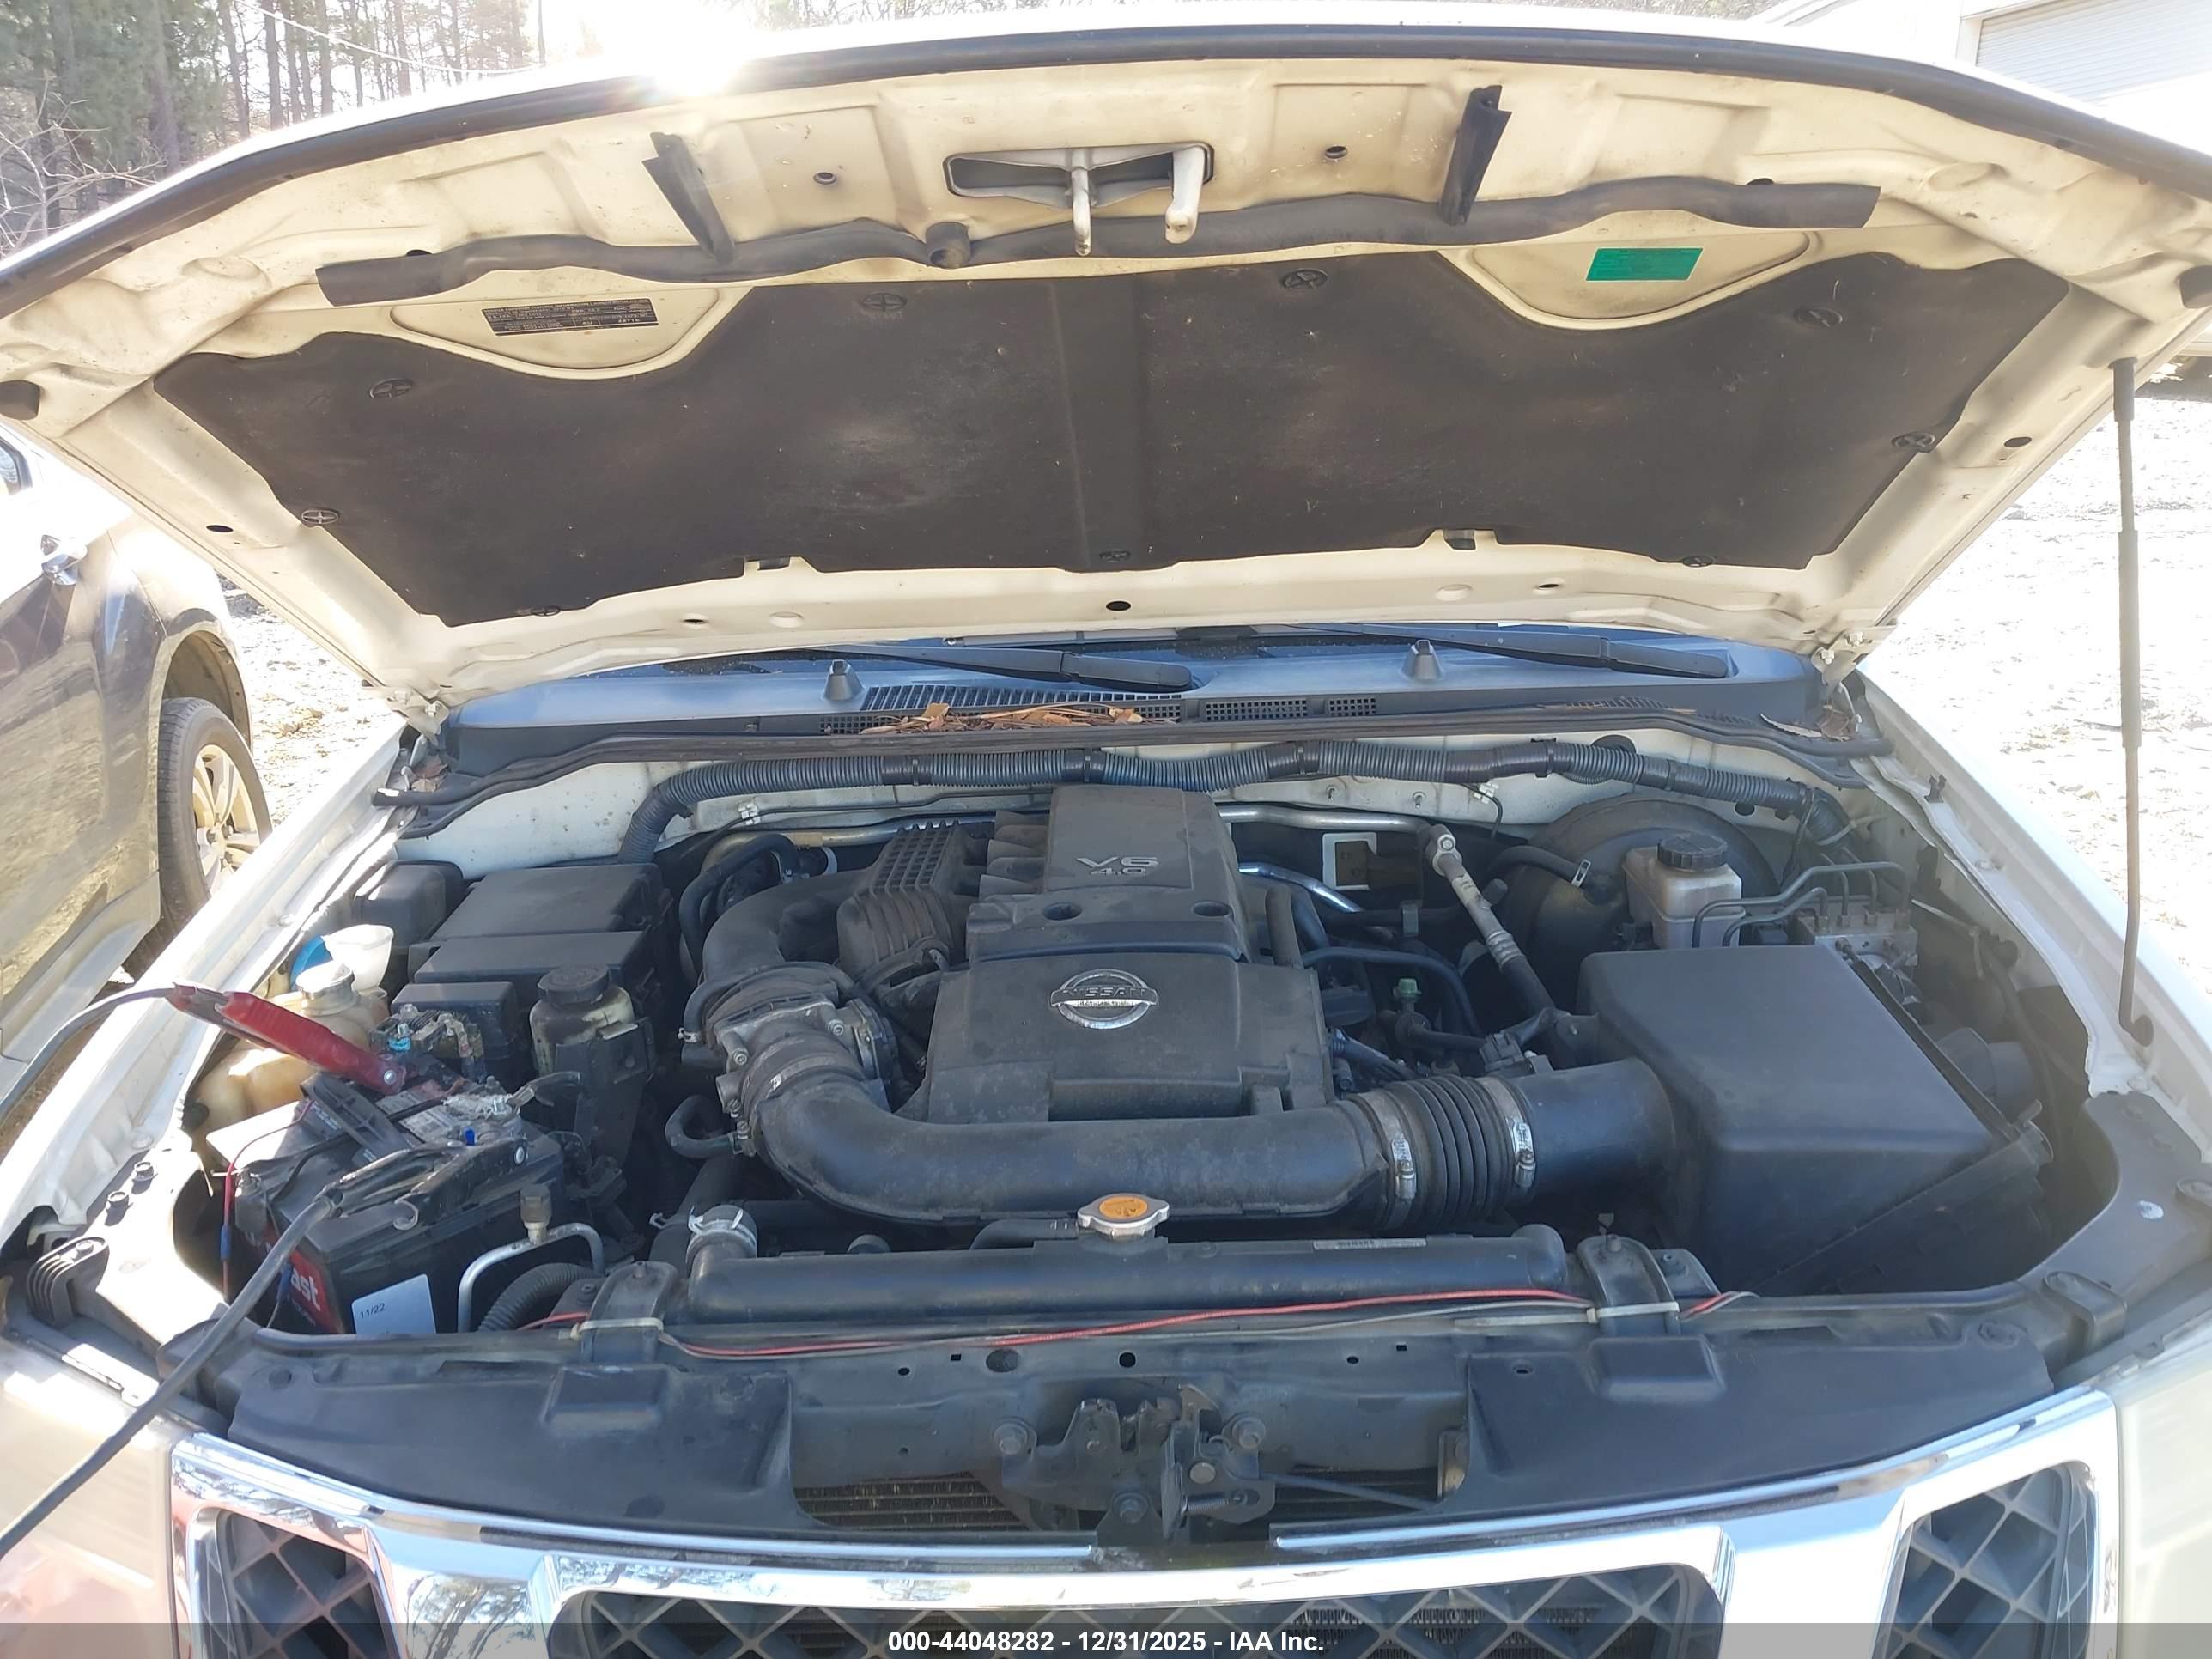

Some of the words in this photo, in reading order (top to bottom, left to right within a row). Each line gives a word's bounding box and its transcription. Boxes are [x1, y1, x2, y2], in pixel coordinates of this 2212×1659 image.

[1076, 857, 1159, 868] V6
[1062, 987, 1147, 998] NISSAN
[360, 1303, 386, 1319] 11/22
